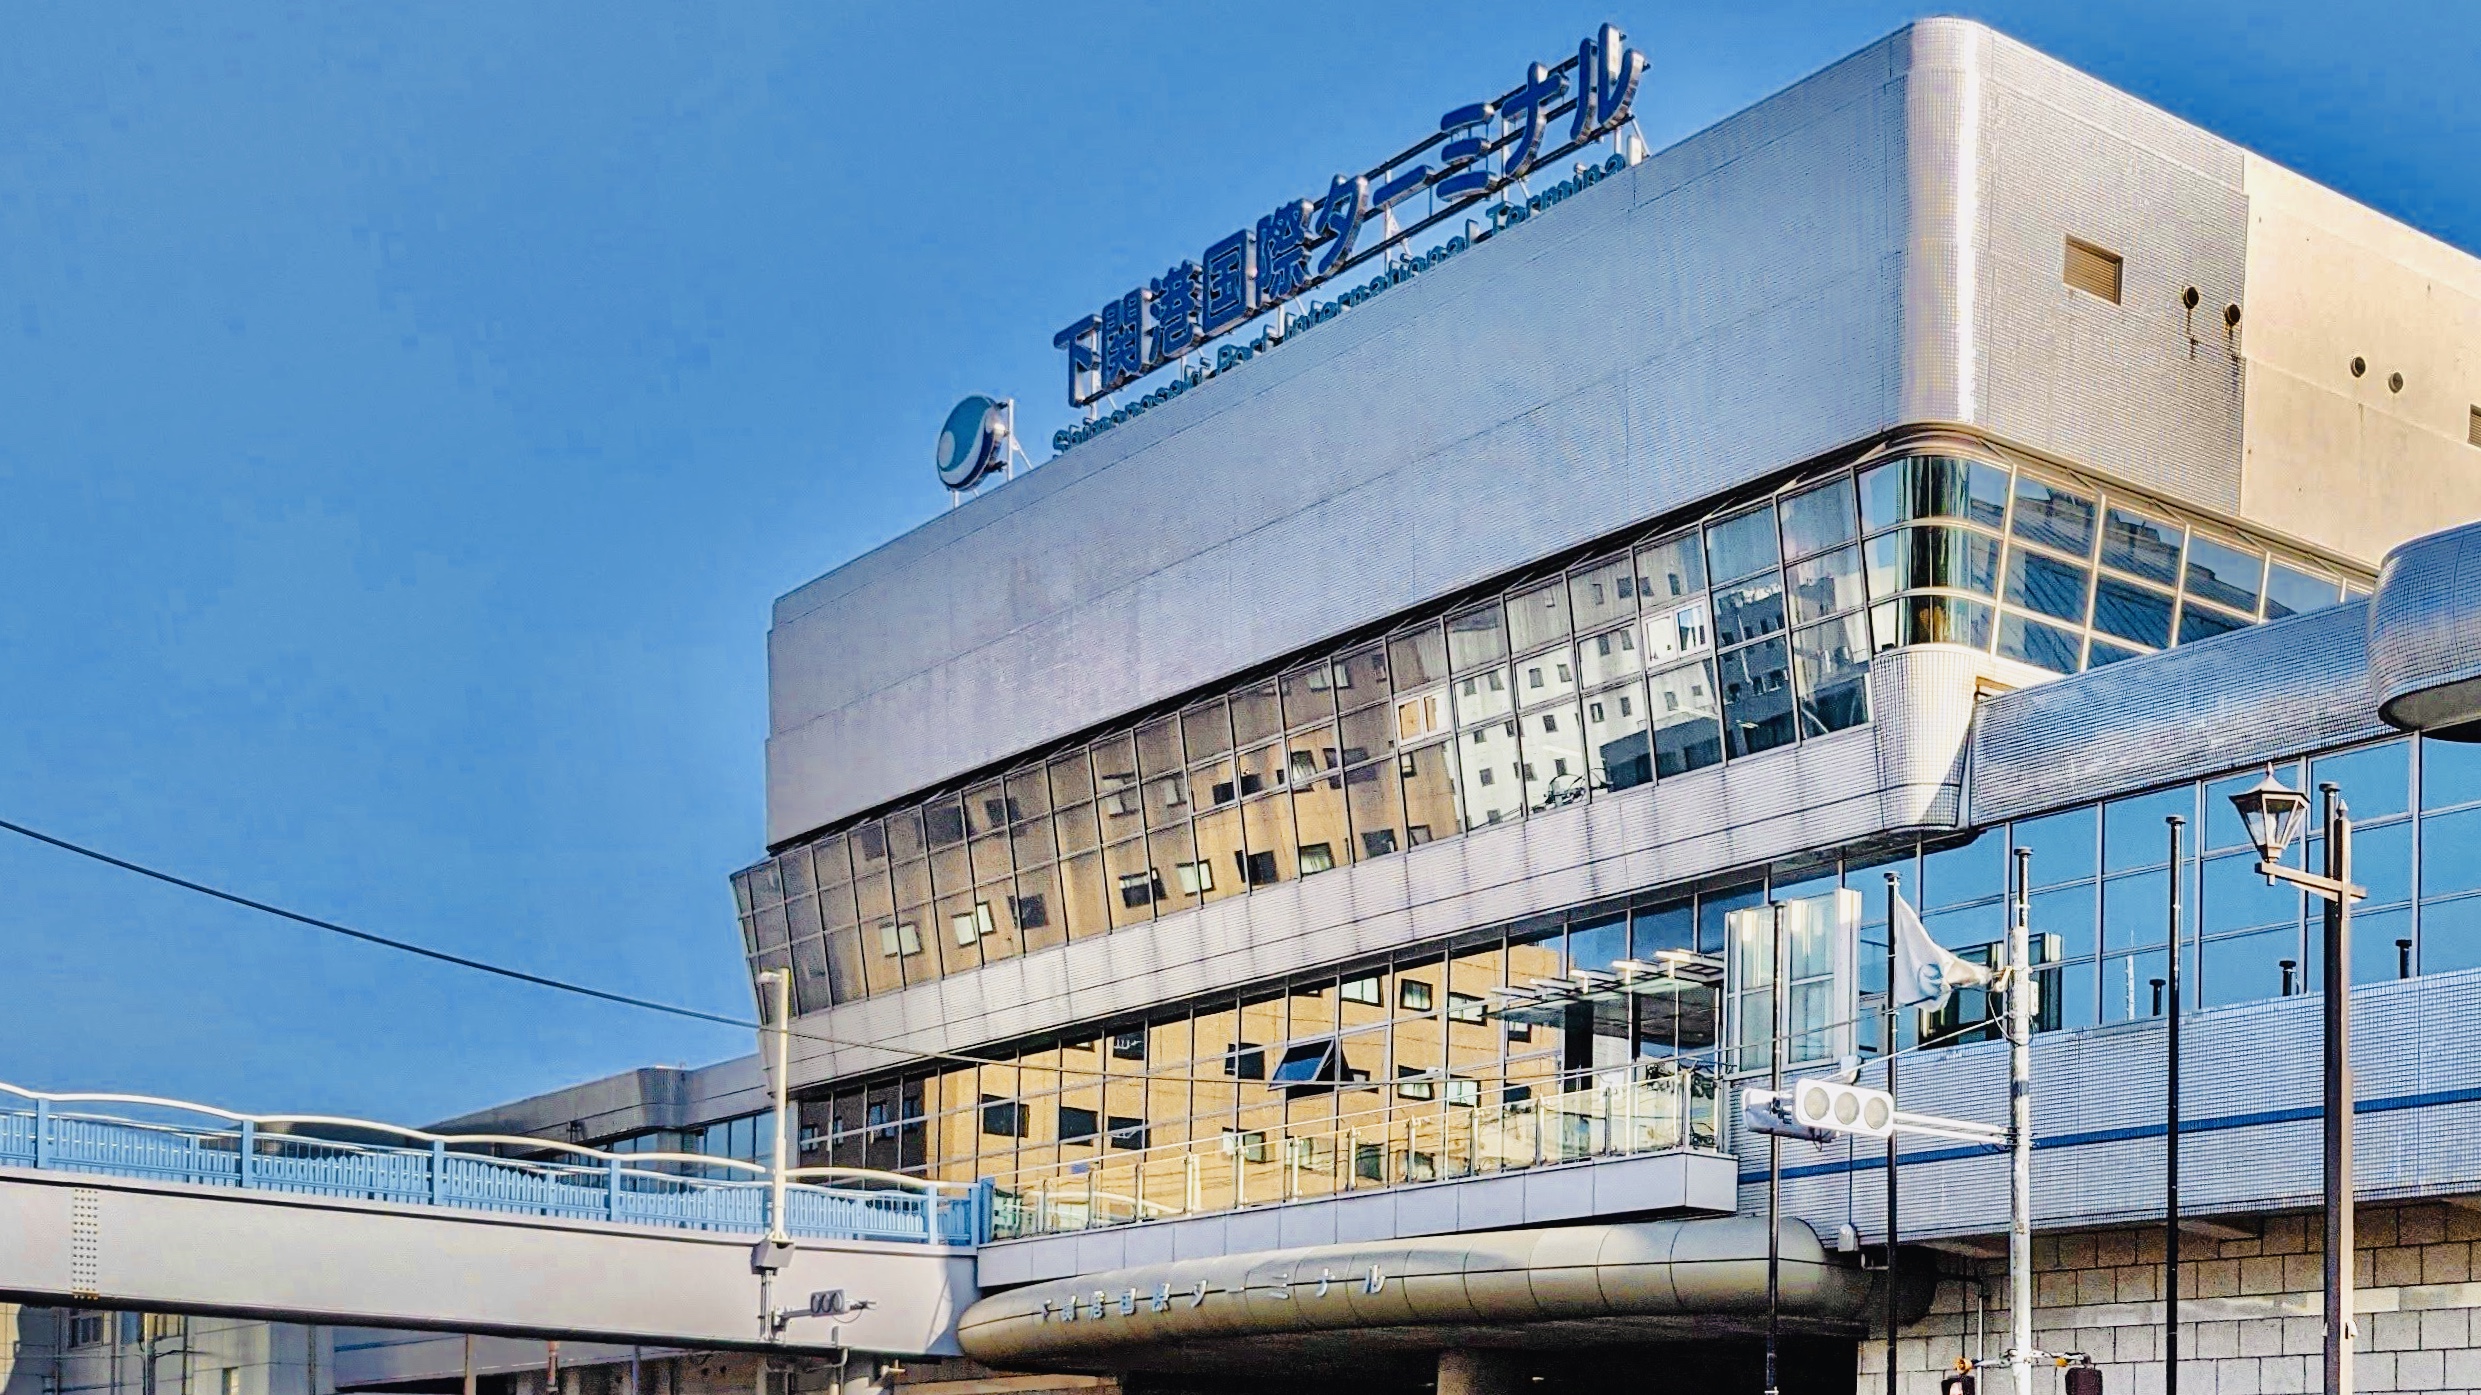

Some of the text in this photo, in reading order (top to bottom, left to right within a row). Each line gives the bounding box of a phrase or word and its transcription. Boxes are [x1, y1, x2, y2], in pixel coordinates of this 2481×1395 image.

[1054, 22, 1645, 408] 下関港国際ターミナル
[1217, 324, 1276, 375] Port
